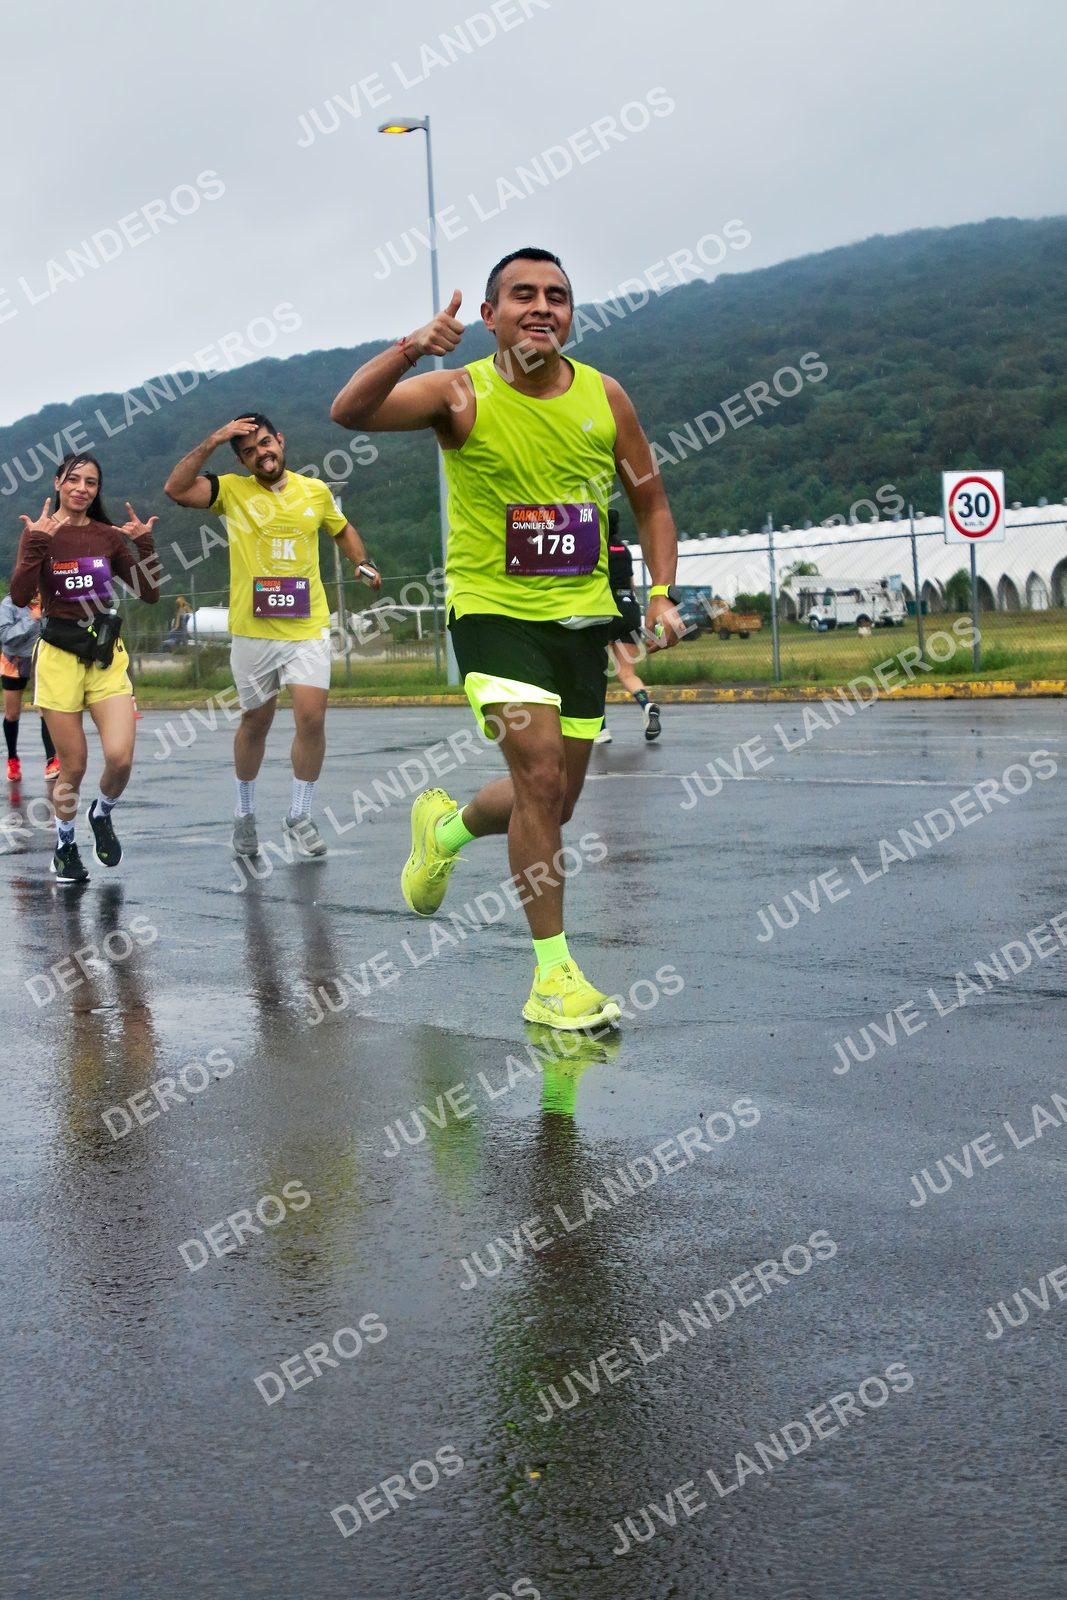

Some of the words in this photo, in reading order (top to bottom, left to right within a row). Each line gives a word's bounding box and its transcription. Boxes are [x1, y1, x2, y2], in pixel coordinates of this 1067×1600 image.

[958, 492, 990, 518] 30
[580, 508, 593, 522] 15K
[283, 539, 296, 560] K
[533, 534, 575, 554] 178
[65, 575, 93, 589] 638
[268, 594, 295, 606] 639
